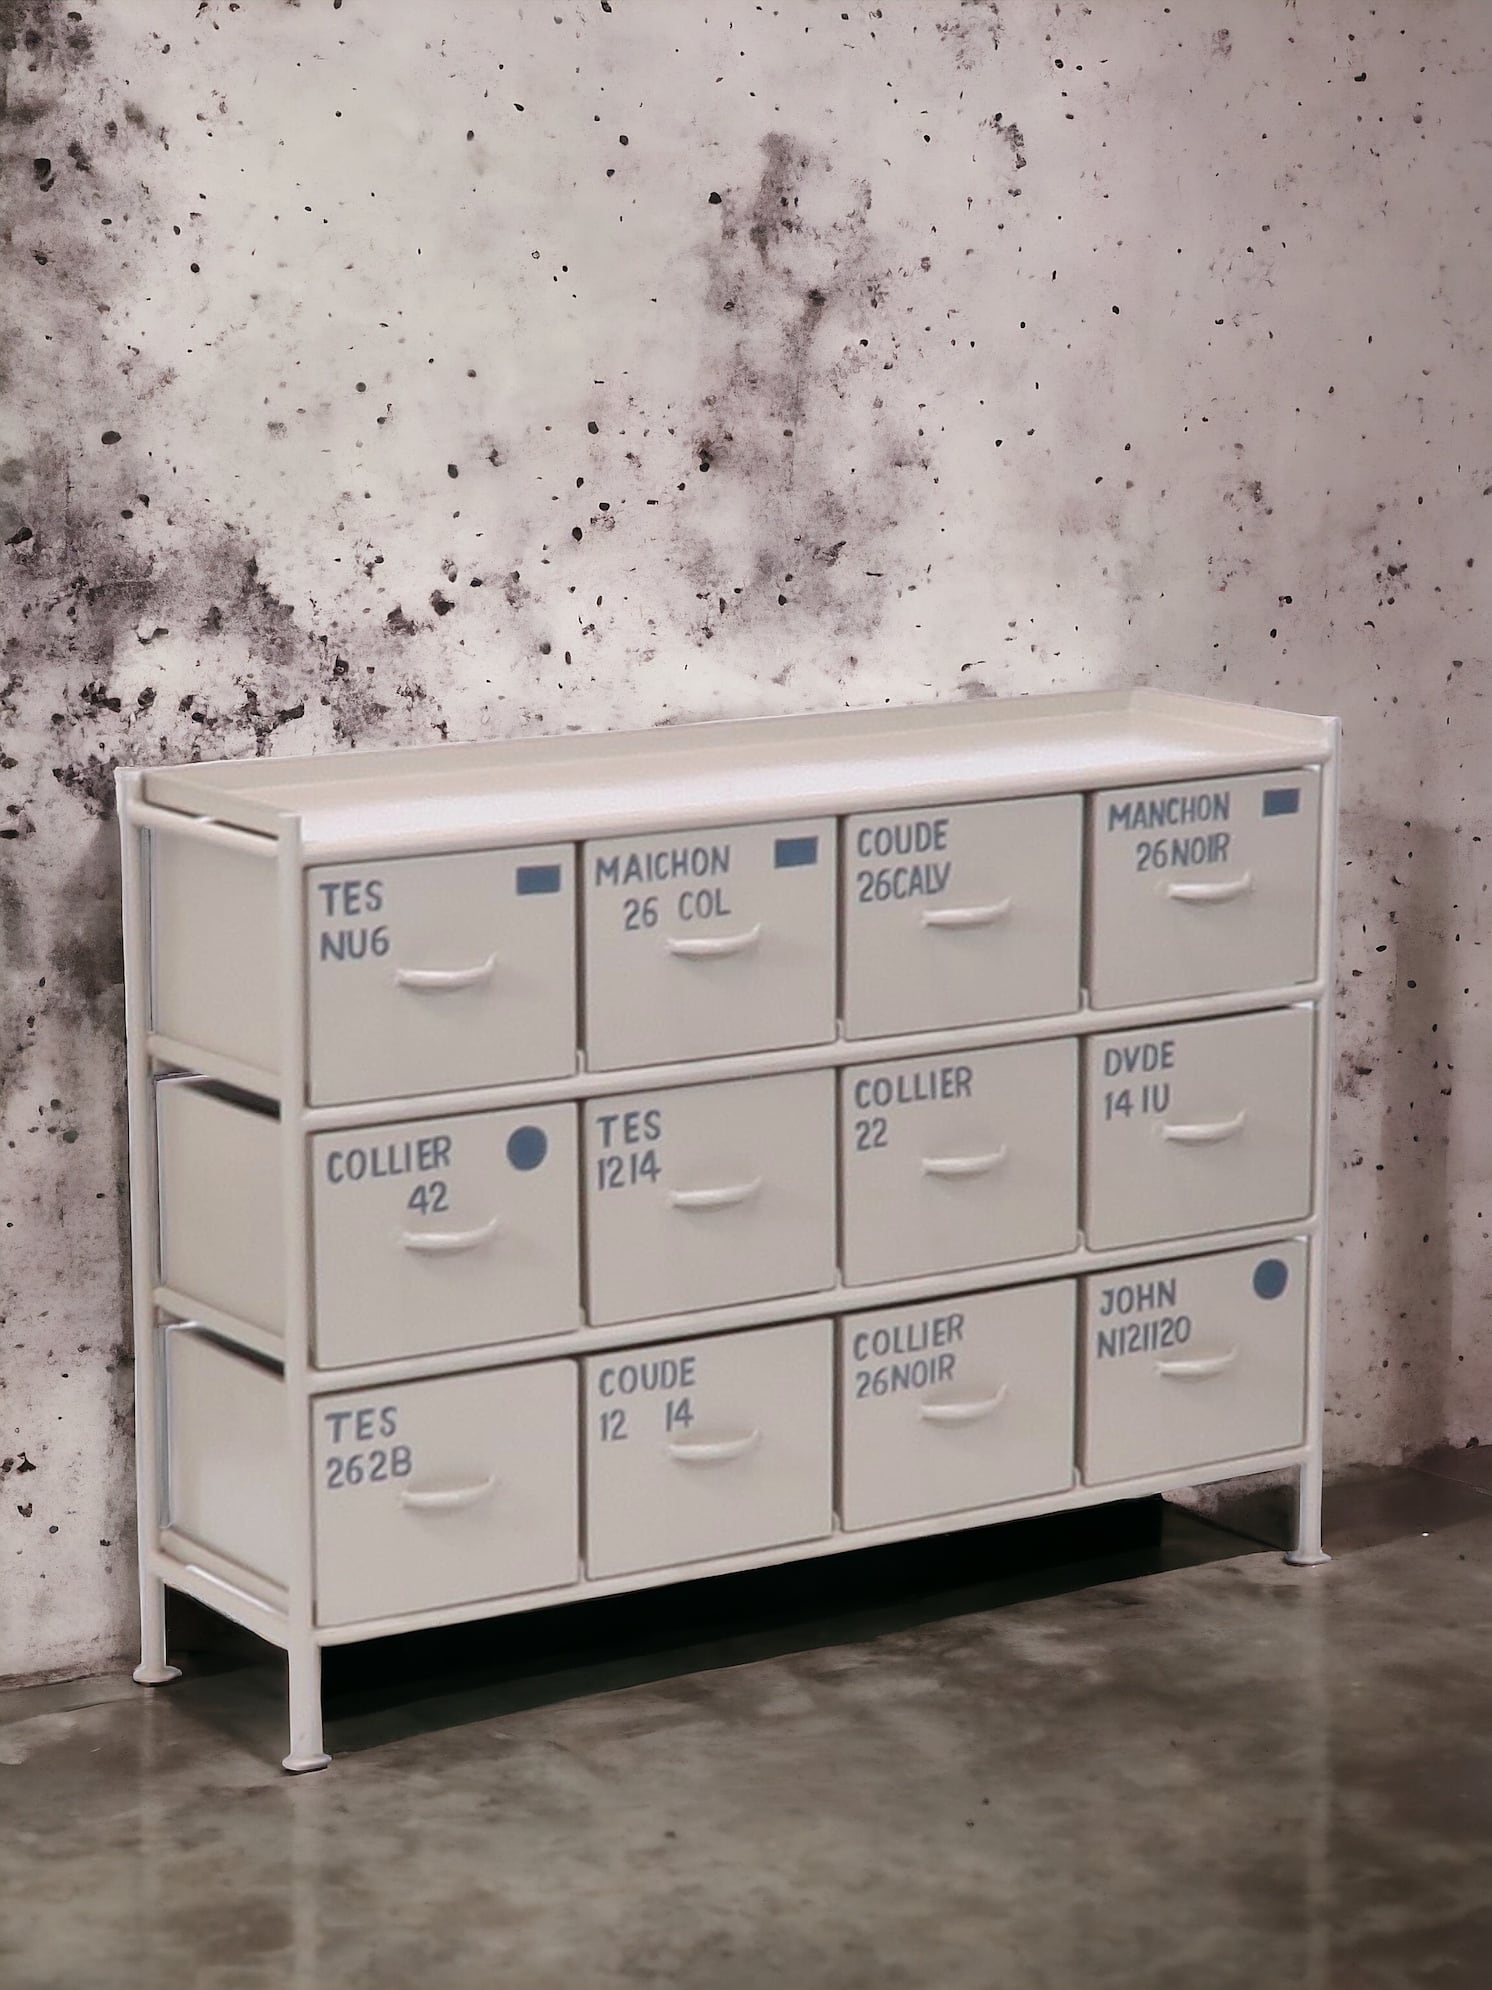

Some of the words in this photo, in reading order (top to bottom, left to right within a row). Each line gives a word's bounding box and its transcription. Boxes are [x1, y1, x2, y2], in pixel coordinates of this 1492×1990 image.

[1108, 790, 1229, 831] MANCHON
[858, 819, 949, 856] COUDE
[596, 845, 730, 886] MAICHON
[318, 880, 382, 916] TES
[624, 897, 658, 931] 26
[679, 888, 731, 921] COL
[321, 925, 389, 961] NU6
[1105, 1040, 1174, 1076] DVDE
[855, 1065, 972, 1109] COLLIER
[597, 1110, 661, 1147] TES
[855, 1118, 888, 1150] 22
[327, 1135, 452, 1185] COLLIER
[598, 1149, 661, 1190] 1214
[407, 1181, 449, 1215] 42
[1101, 1278, 1176, 1315] JOHN
[853, 1312, 964, 1362] COLLIER
[599, 1355, 695, 1397] COUDE
[325, 1406, 397, 1443] TES
[601, 1409, 627, 1441] 12
[666, 1398, 694, 1432] 14
[326, 1445, 412, 1489] 262B
